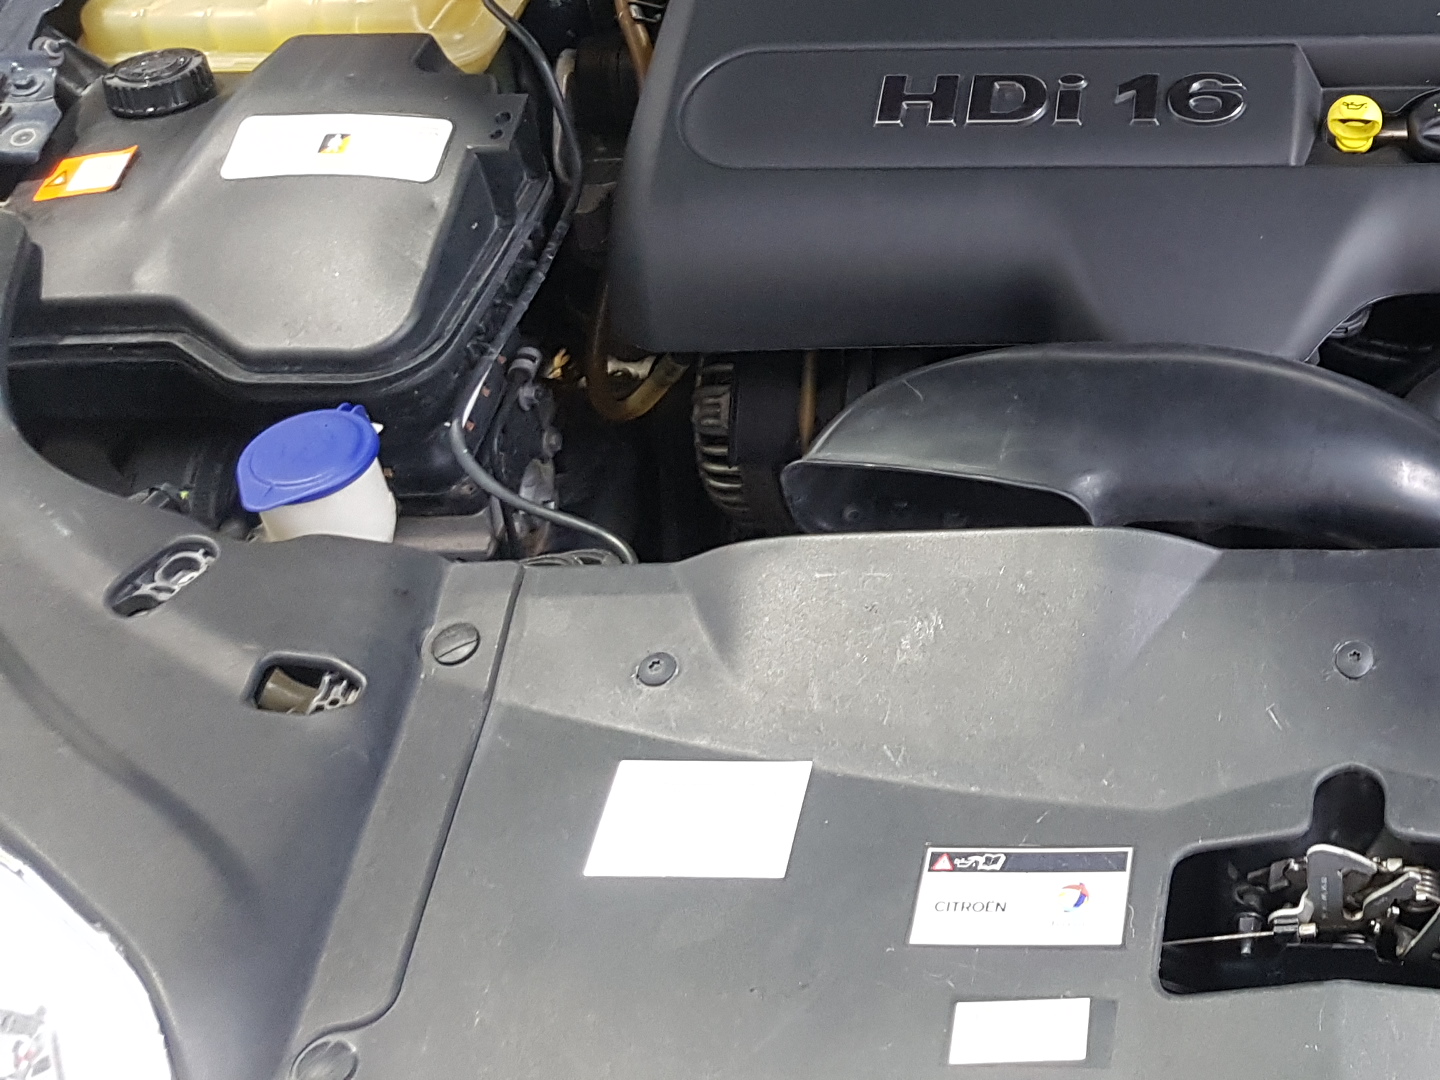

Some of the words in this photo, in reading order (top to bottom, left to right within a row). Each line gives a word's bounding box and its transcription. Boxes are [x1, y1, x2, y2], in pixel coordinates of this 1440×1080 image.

[873, 72, 1088, 127] HDi
[1113, 71, 1248, 127] 16
[934, 900, 1007, 912] CITROËN
